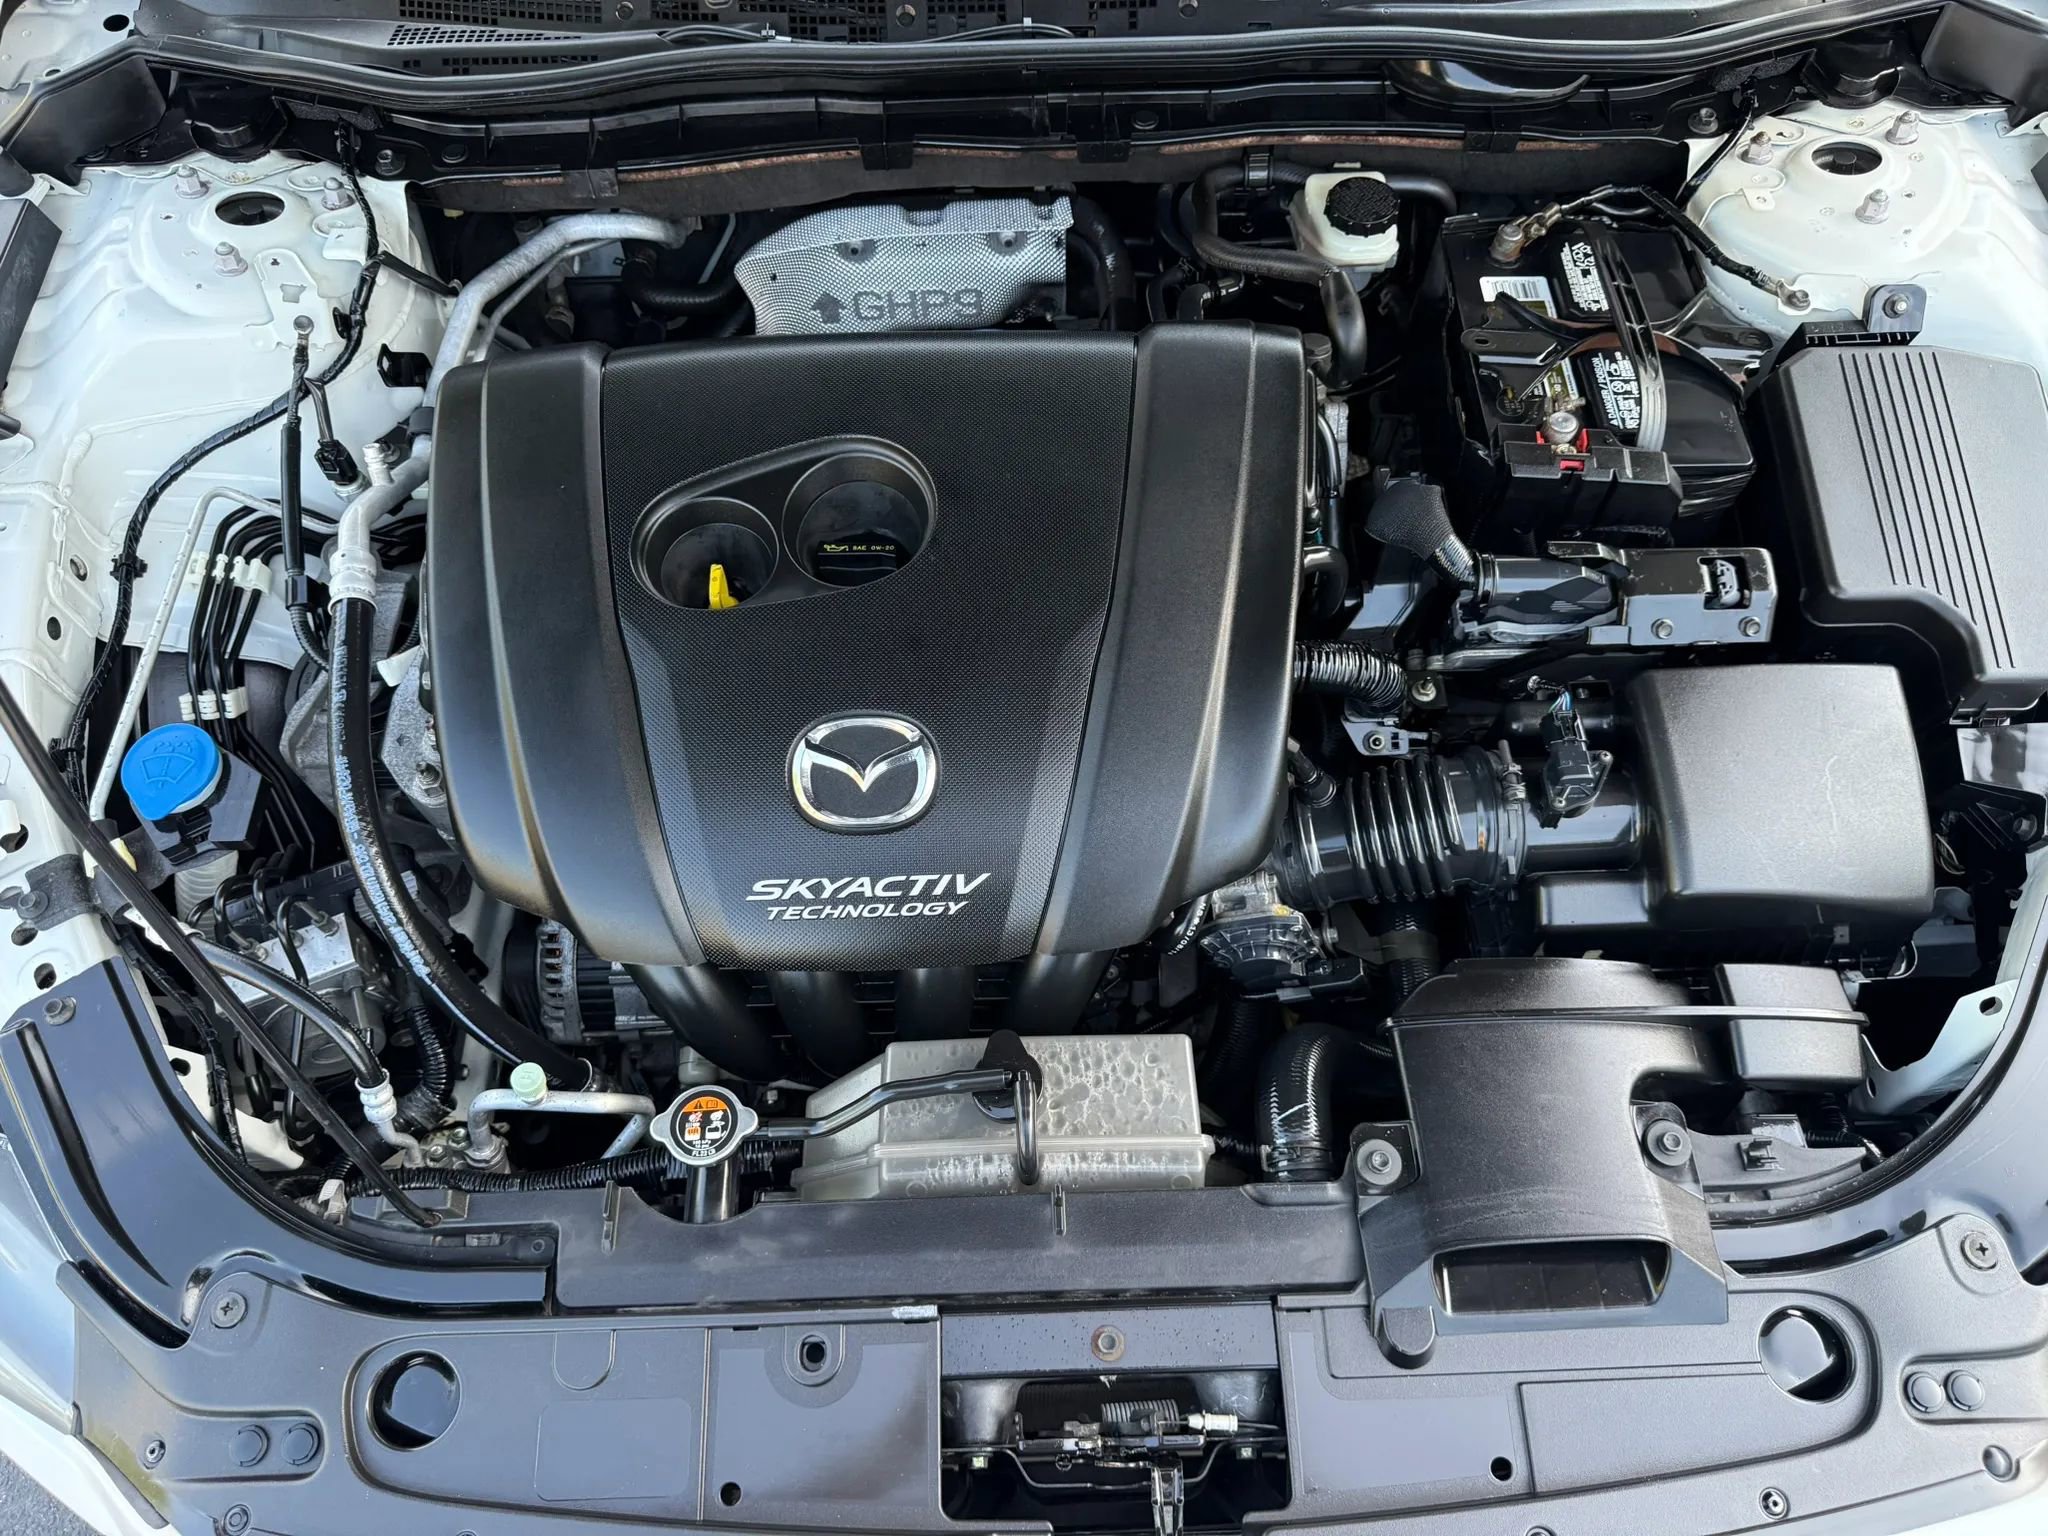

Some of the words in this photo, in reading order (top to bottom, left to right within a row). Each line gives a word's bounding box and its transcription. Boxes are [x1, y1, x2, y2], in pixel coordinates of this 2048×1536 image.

[853, 288, 982, 320] GHP9
[1591, 357, 1607, 383] POISON
[1601, 389, 1617, 419] DANGER
[745, 872, 992, 901] SKYACTIV
[766, 901, 969, 921] TECHNOLOGY
